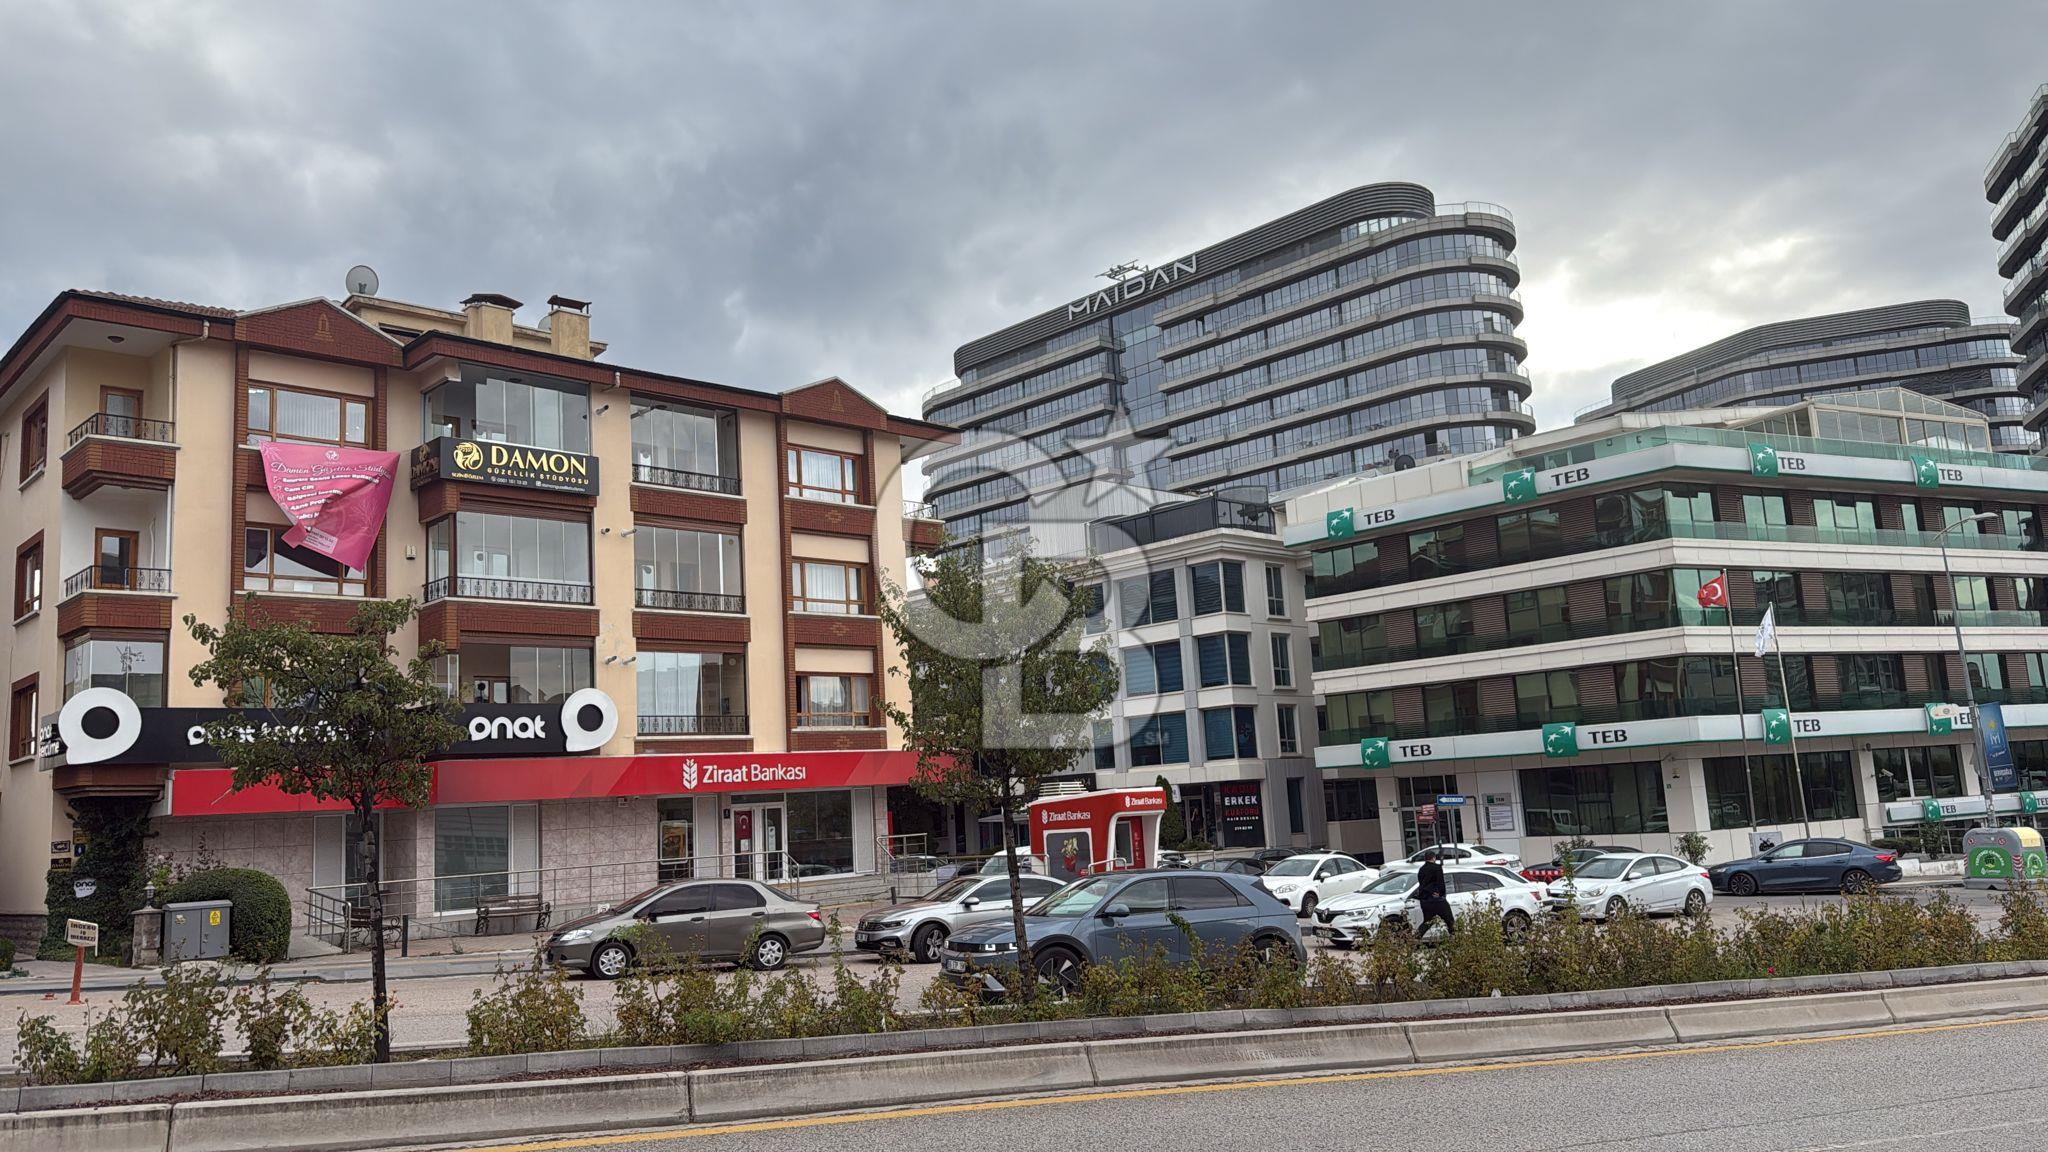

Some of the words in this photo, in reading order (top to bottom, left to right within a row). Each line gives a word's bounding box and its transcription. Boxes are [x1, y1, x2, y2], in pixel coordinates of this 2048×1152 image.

[1069, 255, 1197, 321] MAIDAN
[491, 445, 586, 476] DAMON
[1780, 457, 1806, 470] TEB
[487, 467, 536, 479] GÜZELLİK
[539, 474, 590, 485] STÜDYOSU
[1551, 467, 1590, 486] TEB
[1938, 468, 1963, 481] TEB
[1364, 509, 1395, 525] TEB
[469, 714, 546, 741] onat
[1793, 719, 1821, 733] TEB
[1588, 729, 1628, 745] TEB
[1399, 744, 1432, 758] TEB
[702, 764, 748, 783] Ziraat
[750, 763, 806, 781] Bankası
[1130, 797, 1144, 806] Ziraat
[1224, 795, 1258, 806] ERKEK
[1048, 811, 1067, 822] Ziraat
[1067, 810, 1091, 821] Bankası
[1941, 805, 1957, 814] TEB
